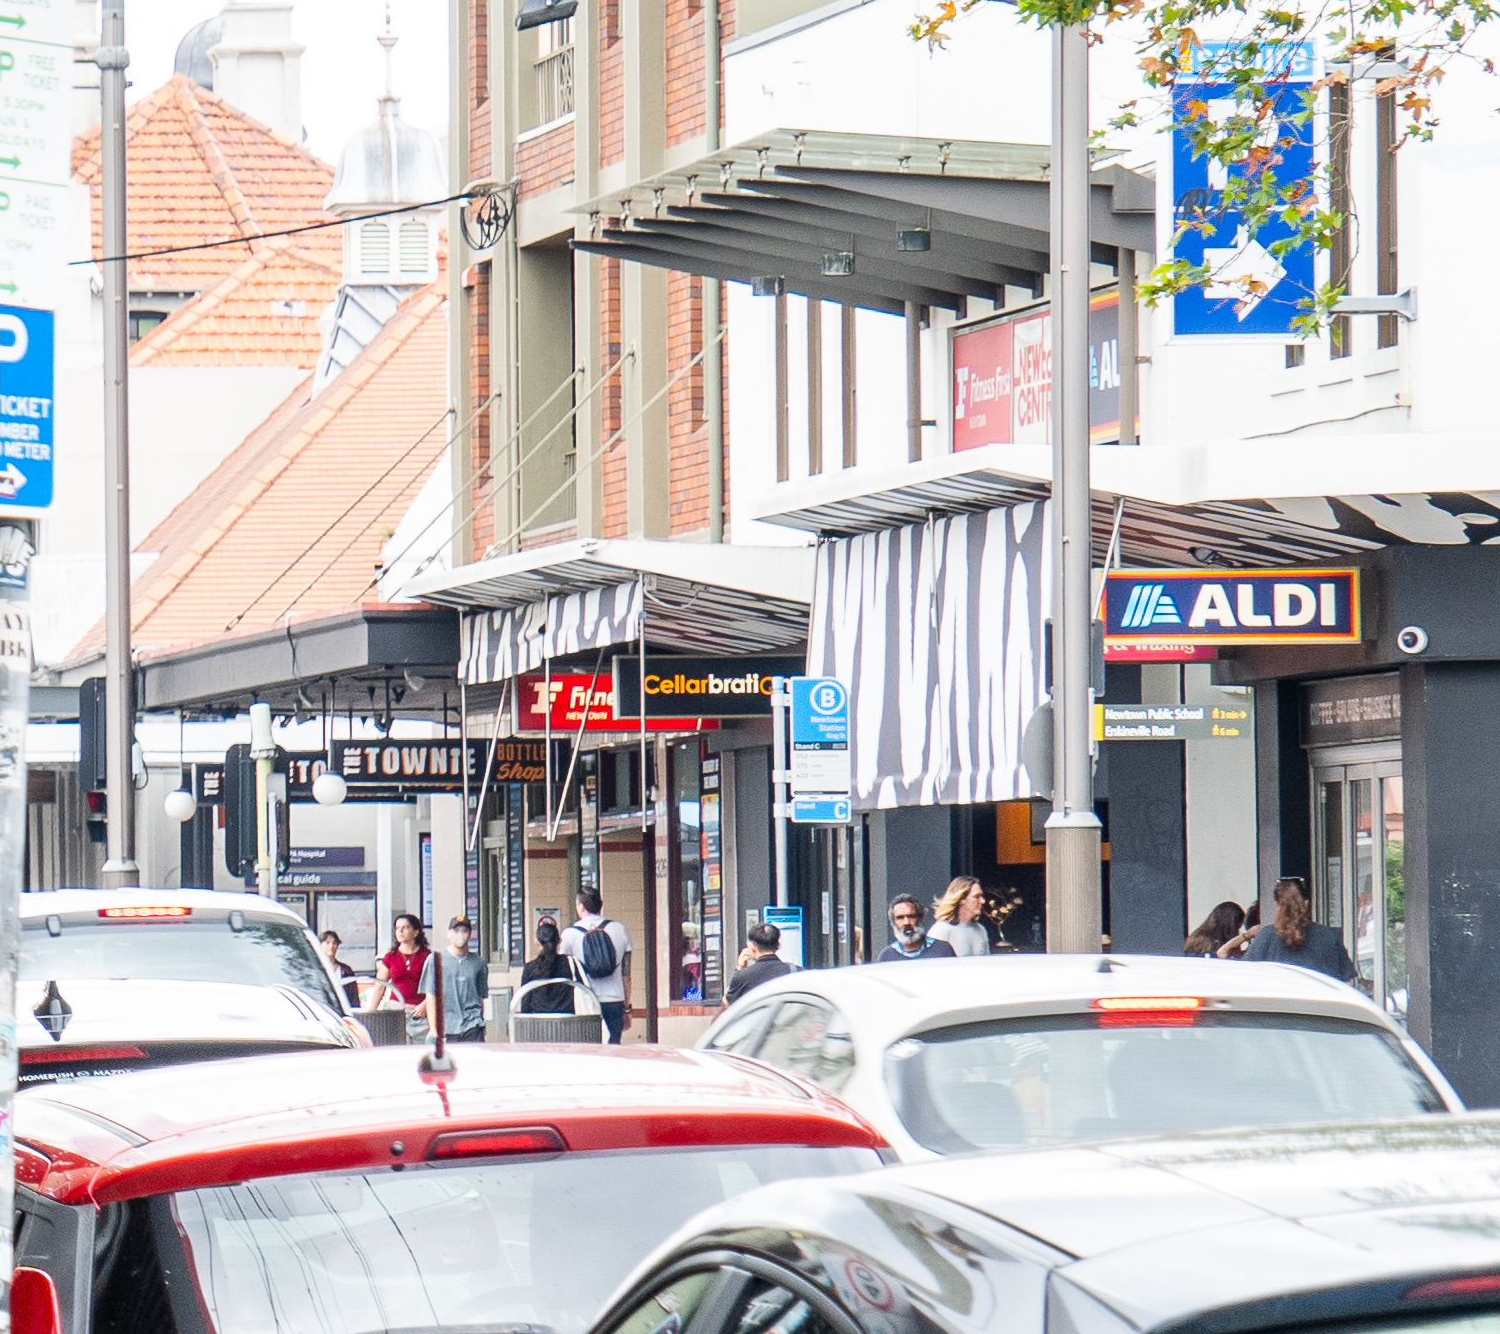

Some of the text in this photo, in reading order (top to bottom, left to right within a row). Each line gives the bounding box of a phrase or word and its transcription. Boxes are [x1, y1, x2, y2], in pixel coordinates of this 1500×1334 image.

[4, 440, 50, 460] METER
[1187, 582, 1337, 628] ALDI
[820, 688, 836, 708] B
[1104, 708, 1147, 720] Newtown
[1149, 708, 1174, 720] Public
[1175, 707, 1204, 720] School
[343, 746, 476, 776] THE TOWNIE
[495, 743, 546, 782] BOTTLE Shop
[834, 802, 847, 819] C
[293, 872, 322, 887] guide
[17, 1071, 75, 1082] HOMEBUSH
